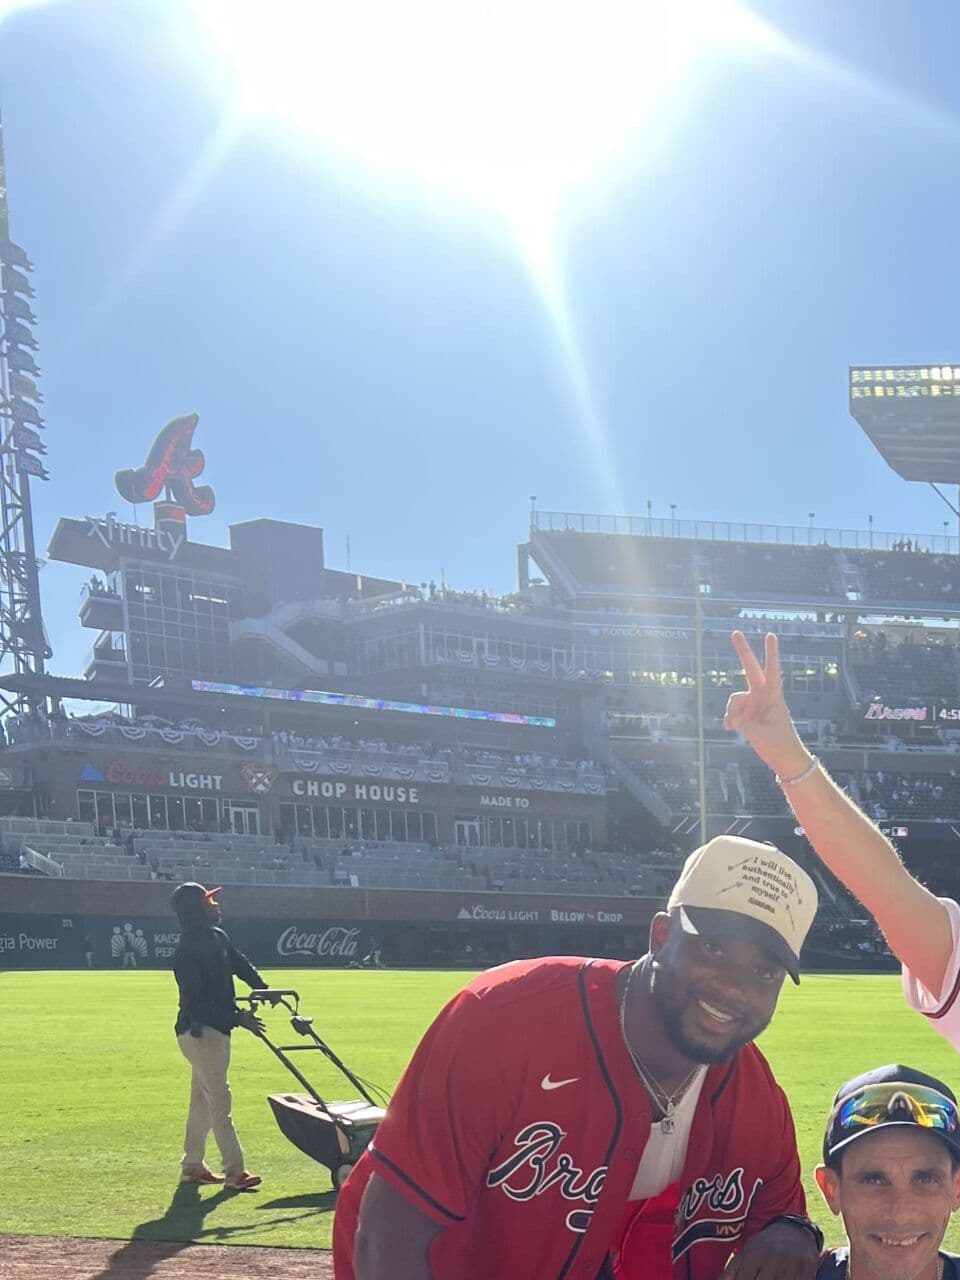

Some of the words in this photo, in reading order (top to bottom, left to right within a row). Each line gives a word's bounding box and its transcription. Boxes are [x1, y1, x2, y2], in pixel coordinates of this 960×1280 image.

[85, 511, 183, 560] xfinity
[168, 771, 222, 790] LIGHT
[293, 780, 347, 798] CHOP
[355, 784, 419, 803] HOUSE
[480, 795, 513, 807] MADE
[515, 797, 530, 808] TO
[761, 858, 778, 871] will
[779, 867, 792, 880] live
[742, 864, 795, 895] authentically
[742, 873, 760, 884] and
[762, 879, 780, 893] true
[781, 889, 788, 898] to
[751, 885, 780, 902] myself
[508, 911, 538, 920] LIGHT
[19, 933, 58, 949] Power
